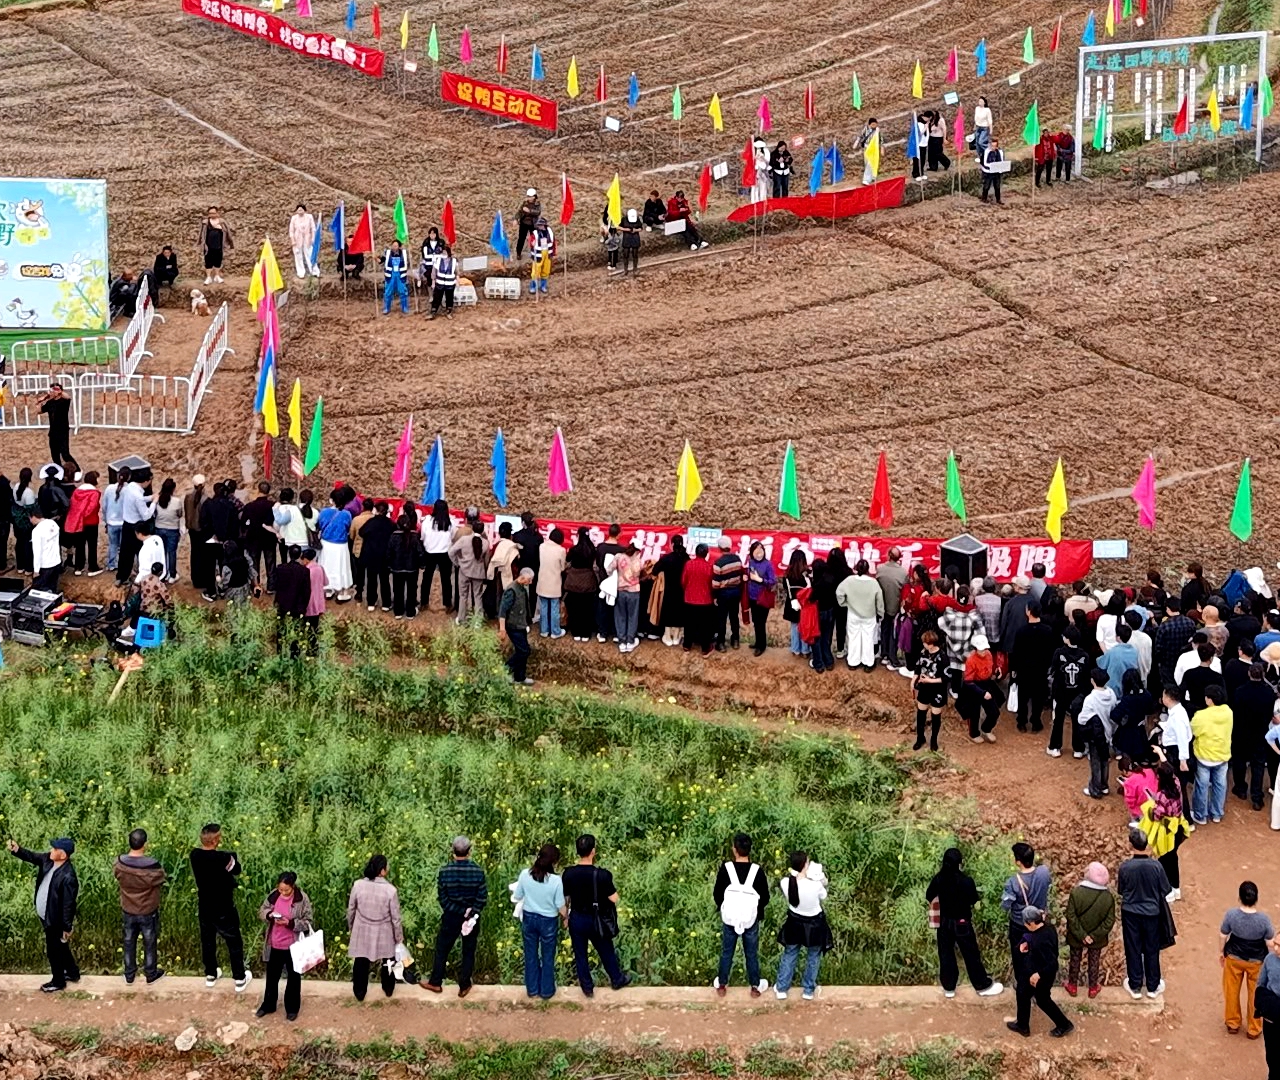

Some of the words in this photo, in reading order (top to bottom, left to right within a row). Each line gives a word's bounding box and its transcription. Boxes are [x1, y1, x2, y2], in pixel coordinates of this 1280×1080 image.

[457, 81, 542, 121] 捉鸭互动区
